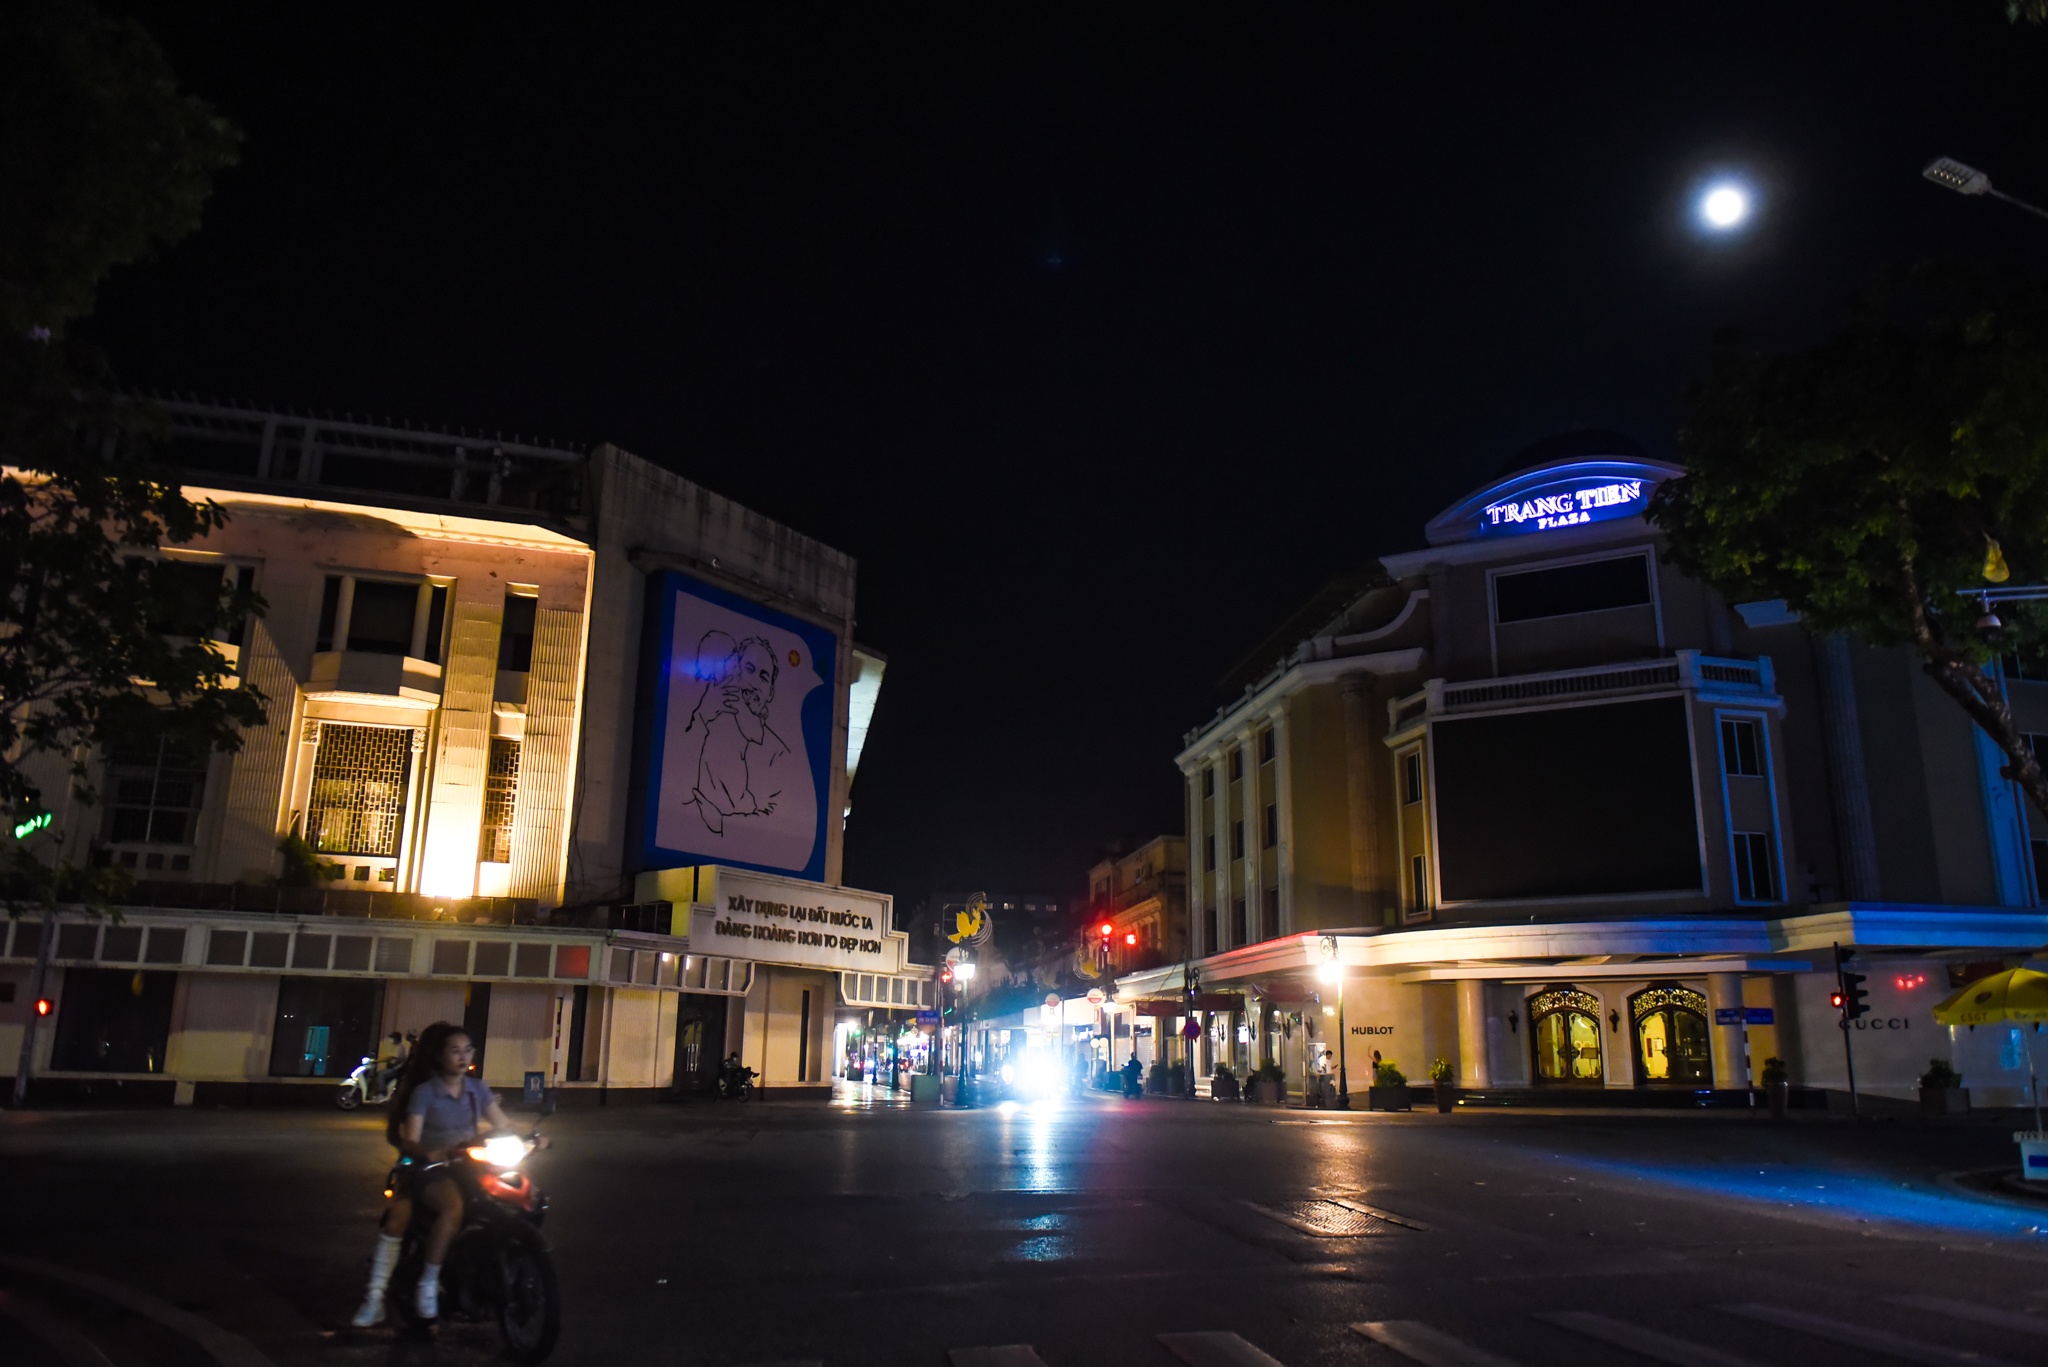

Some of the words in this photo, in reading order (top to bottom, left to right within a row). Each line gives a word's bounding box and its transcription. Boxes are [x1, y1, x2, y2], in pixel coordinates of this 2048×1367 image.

[1486, 492, 1574, 525] TRANG
[1538, 511, 1591, 530] PLAZA
[728, 894, 754, 913] XÂY
[755, 900, 789, 918] DỰNG
[789, 905, 807, 922] LẠI
[808, 905, 829, 924] ĐẤT
[829, 909, 860, 928] NƯỚC
[861, 916, 873, 930] TA
[715, 916, 752, 938] ĐÀNG
[753, 923, 796, 944] HOÀNG
[797, 930, 823, 947] HƠN
[823, 933, 838, 948] TO
[839, 935, 859, 954] ĐẸP
[859, 938, 881, 954] HƠN
[1351, 1026, 1394, 1035] HUBLOT
